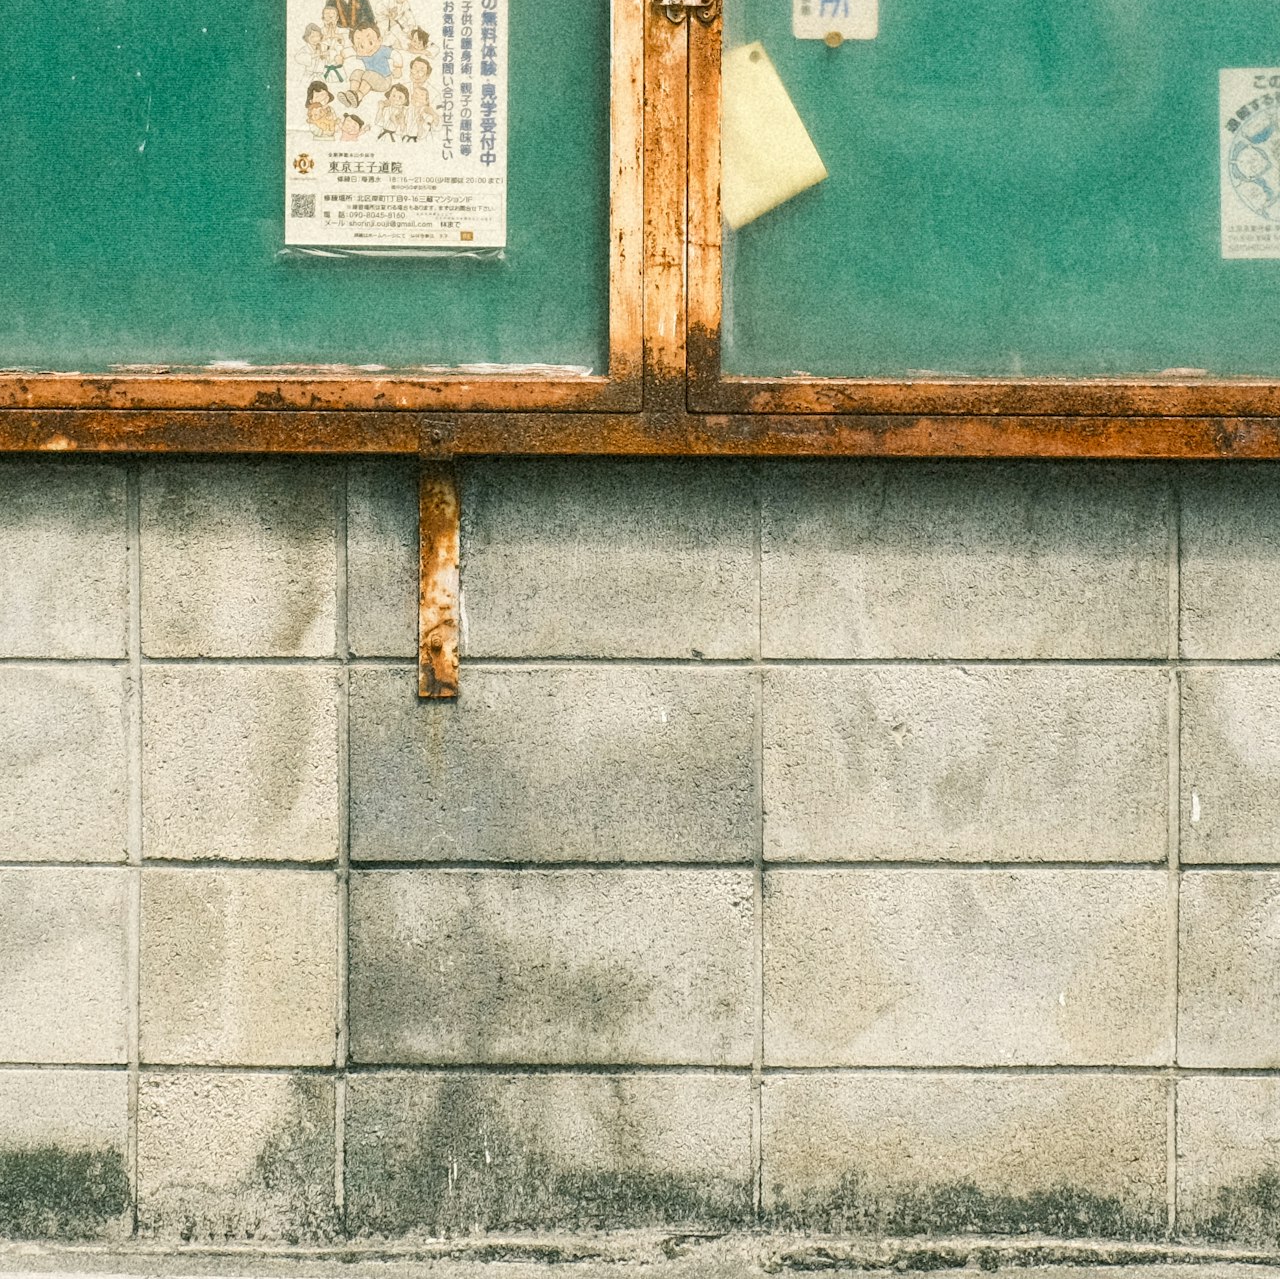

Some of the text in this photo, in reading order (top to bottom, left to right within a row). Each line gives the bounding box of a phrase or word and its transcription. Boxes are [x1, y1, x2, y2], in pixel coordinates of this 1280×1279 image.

[327, 160, 403, 174] 東京王子道院
